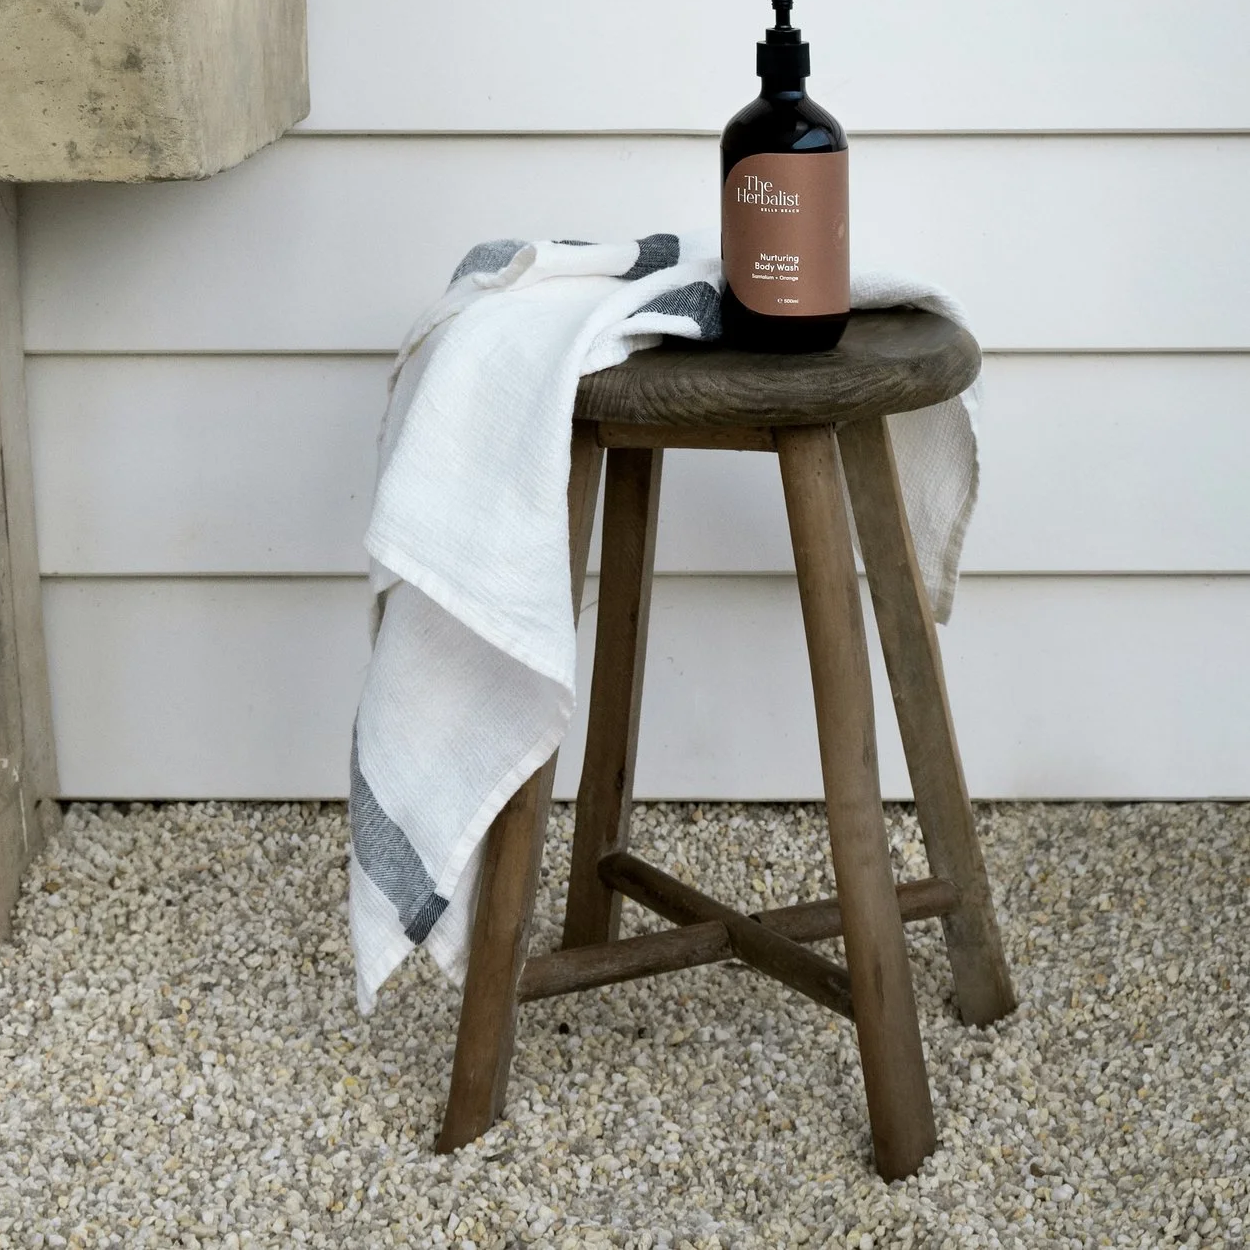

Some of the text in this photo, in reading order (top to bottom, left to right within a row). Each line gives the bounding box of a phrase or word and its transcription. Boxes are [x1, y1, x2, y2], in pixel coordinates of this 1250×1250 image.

[744, 175, 773, 192] The
[737, 187, 800, 206] Herbalist
[760, 253, 799, 264] Nurturing
[754, 262, 799, 272] Body Wash
